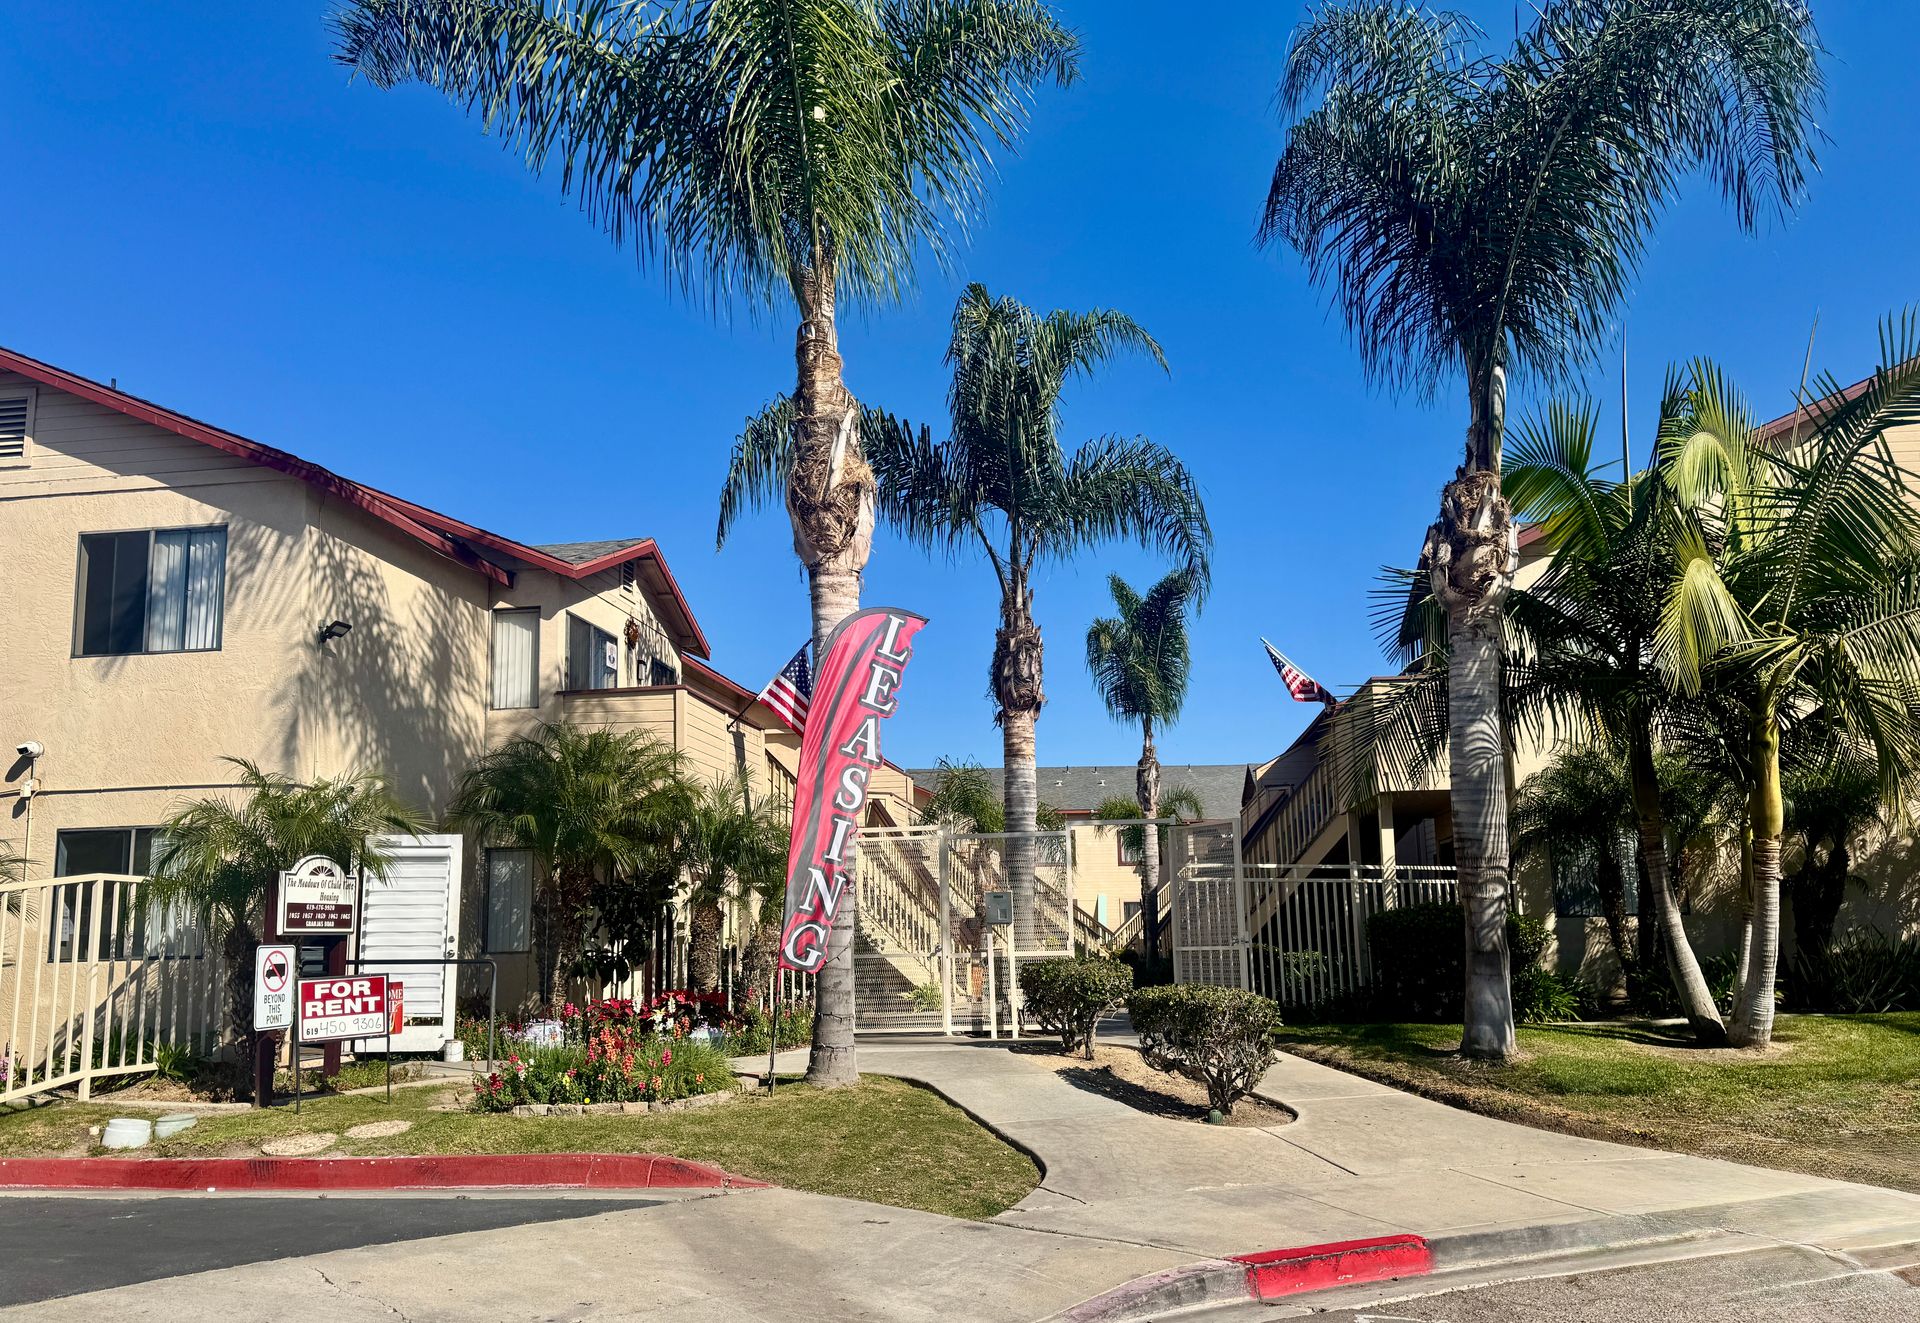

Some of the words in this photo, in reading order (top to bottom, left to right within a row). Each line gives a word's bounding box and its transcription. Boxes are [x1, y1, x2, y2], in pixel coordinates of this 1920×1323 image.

[784, 614, 907, 967] LEASING
[287, 878, 296, 887] The
[320, 892, 339, 903] Housing
[314, 981, 371, 999] FOR
[264, 993, 286, 1004] BEYOND
[269, 1004, 281, 1014] THIS
[305, 996, 381, 1017] RENT
[266, 1014, 282, 1024] POINT
[306, 1027, 319, 1036] 619
[320, 1020, 347, 1035] 450
[352, 1017, 382, 1031] 9306
